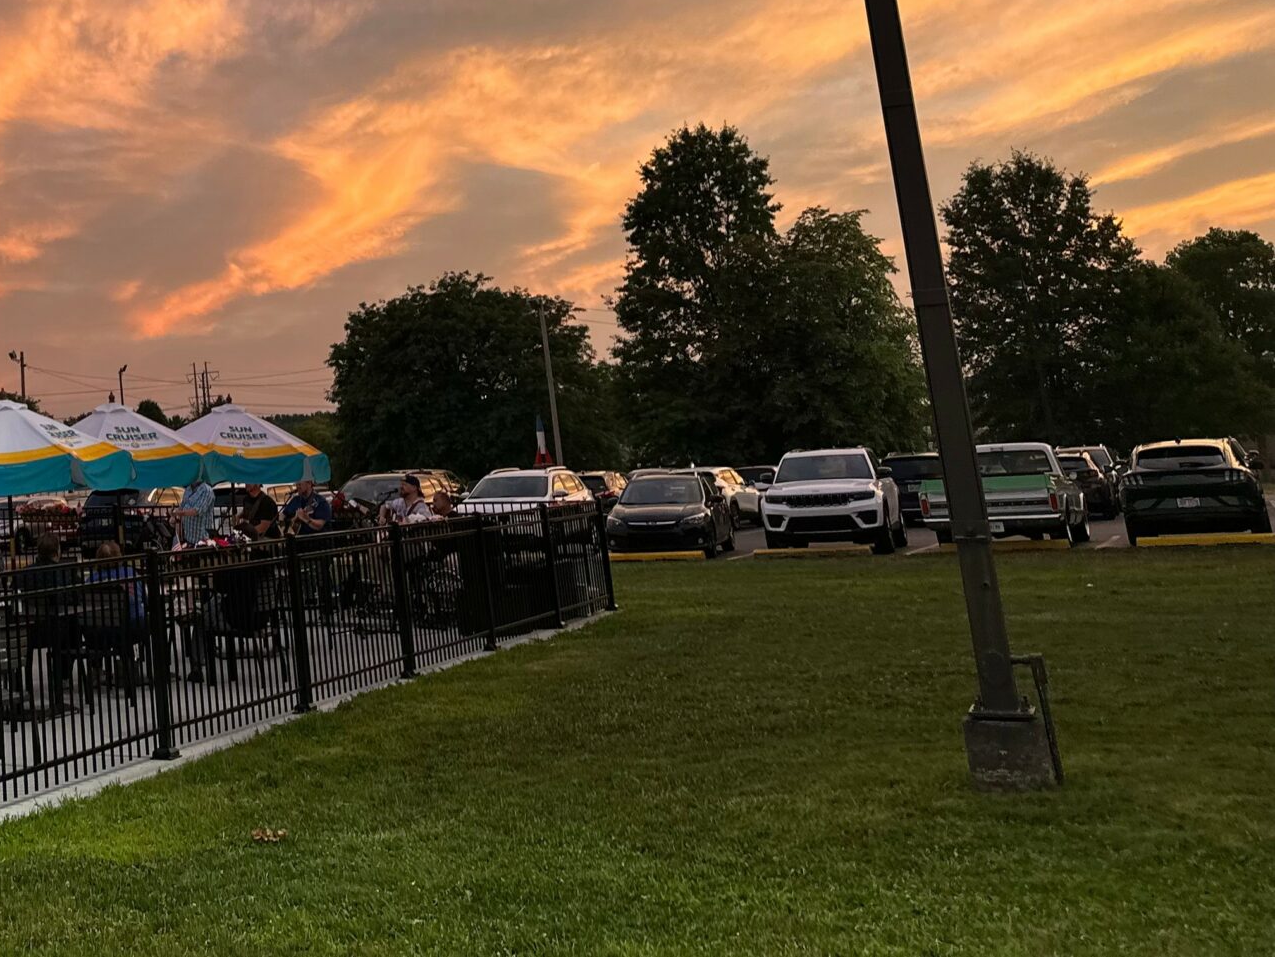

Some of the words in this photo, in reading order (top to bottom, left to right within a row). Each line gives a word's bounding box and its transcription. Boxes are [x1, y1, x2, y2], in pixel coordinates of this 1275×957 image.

[114, 426, 141, 434] SUN
[228, 425, 253, 433] SUN
[105, 432, 159, 441] CRUISER
[219, 431, 268, 440] CRUISER
